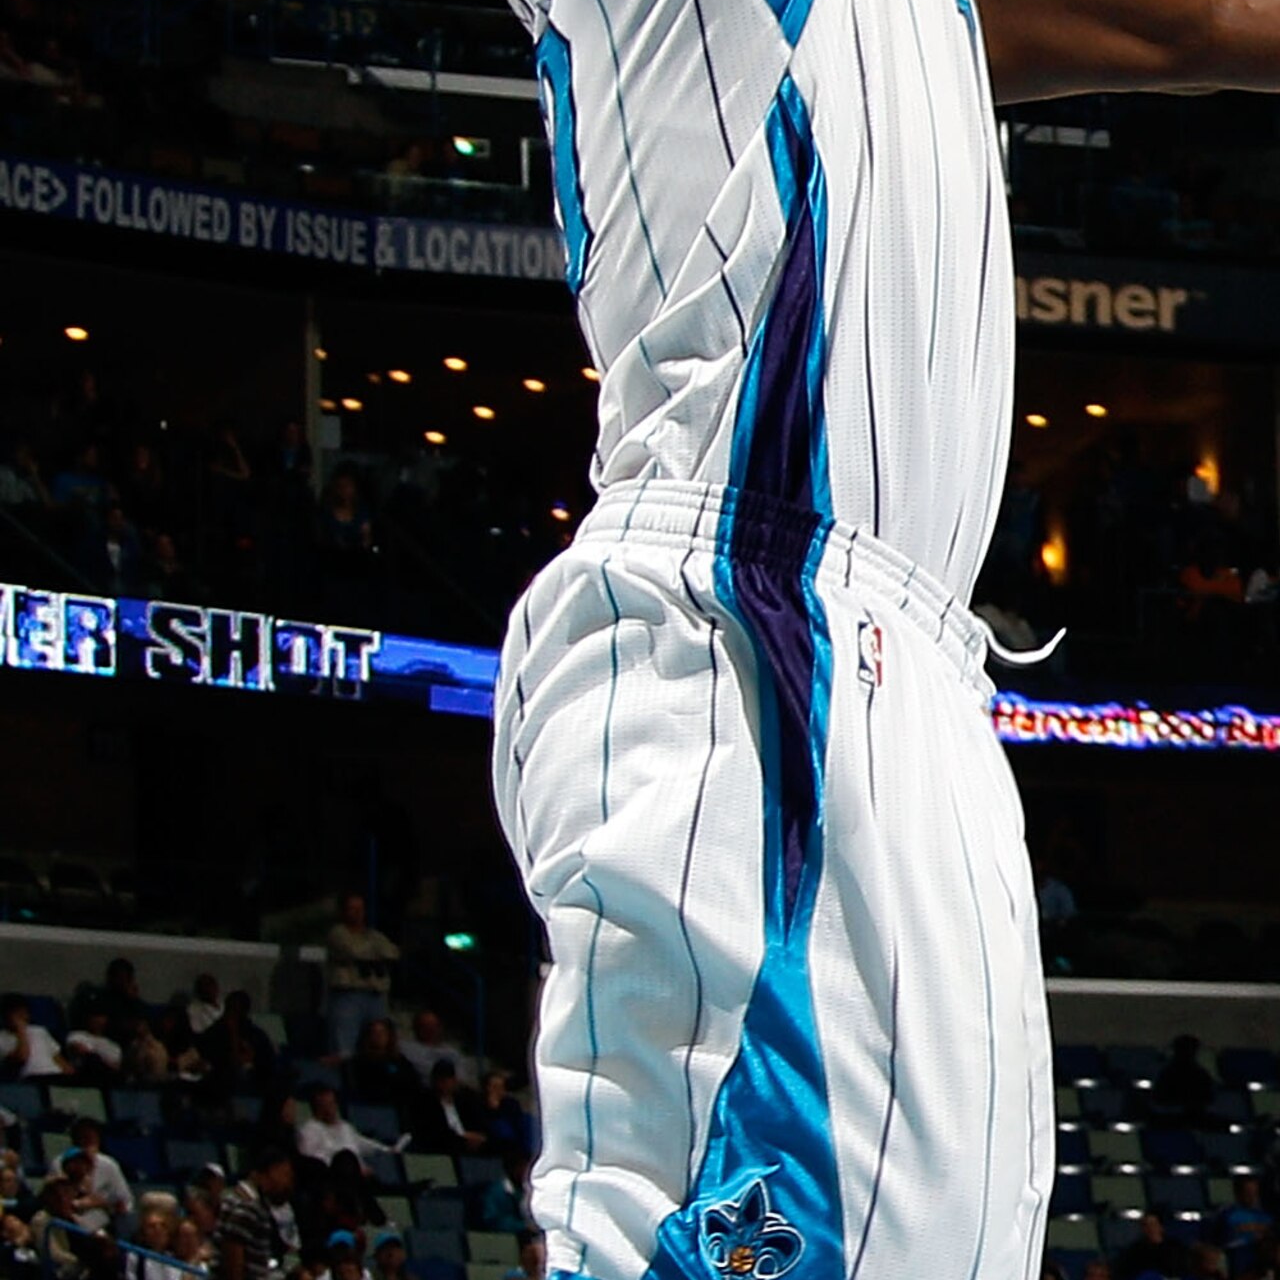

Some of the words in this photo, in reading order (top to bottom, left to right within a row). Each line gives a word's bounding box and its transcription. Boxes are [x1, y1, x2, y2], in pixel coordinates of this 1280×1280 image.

[75, 173, 232, 244] FOLLOWED
[238, 201, 278, 252] BY
[285, 207, 369, 267] ISSUE
[373, 218, 398, 267] &
[145, 600, 382, 700] SHOT
